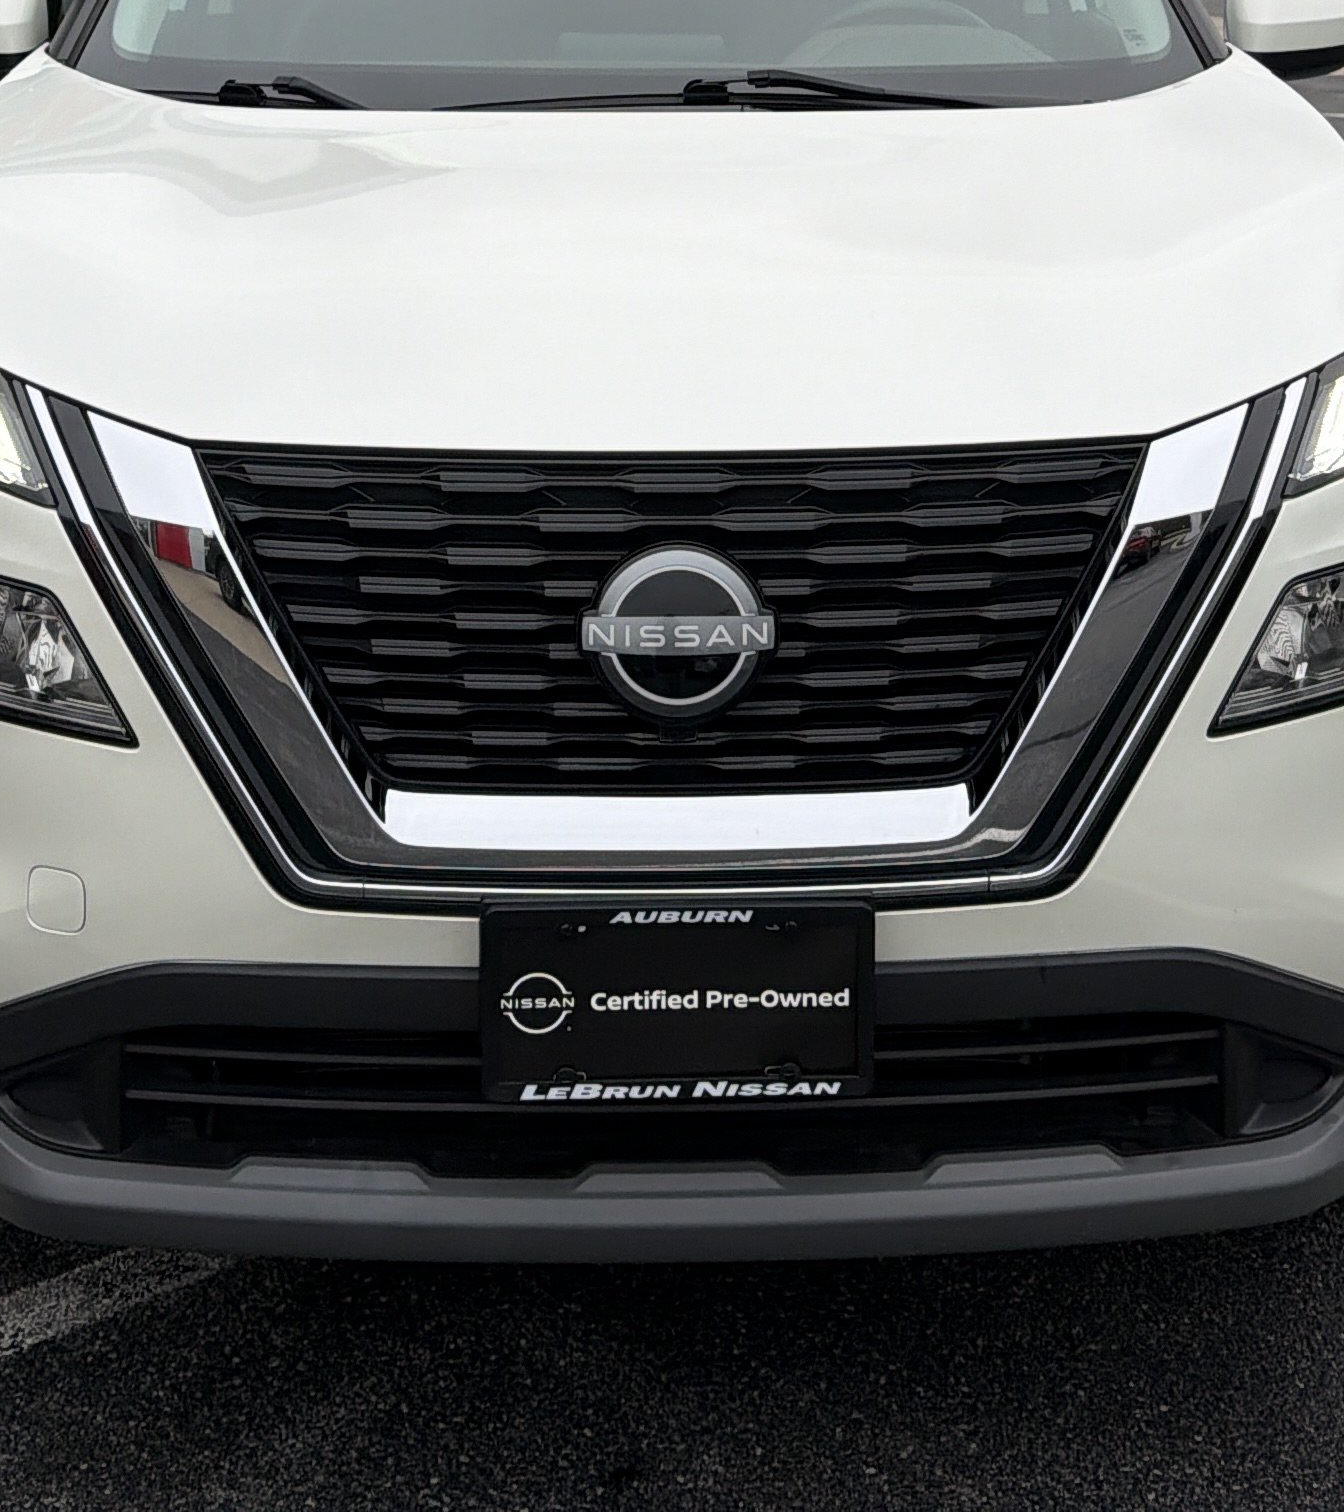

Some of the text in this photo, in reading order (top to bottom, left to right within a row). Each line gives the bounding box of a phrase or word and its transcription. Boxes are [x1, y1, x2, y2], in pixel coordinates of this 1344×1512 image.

[588, 622, 768, 648] NISSAN
[609, 909, 755, 925] AUBURN
[500, 996, 575, 1011] NISSAN
[590, 988, 850, 1012] Certified Pre-Owned
[691, 1080, 842, 1098] NISSAN
